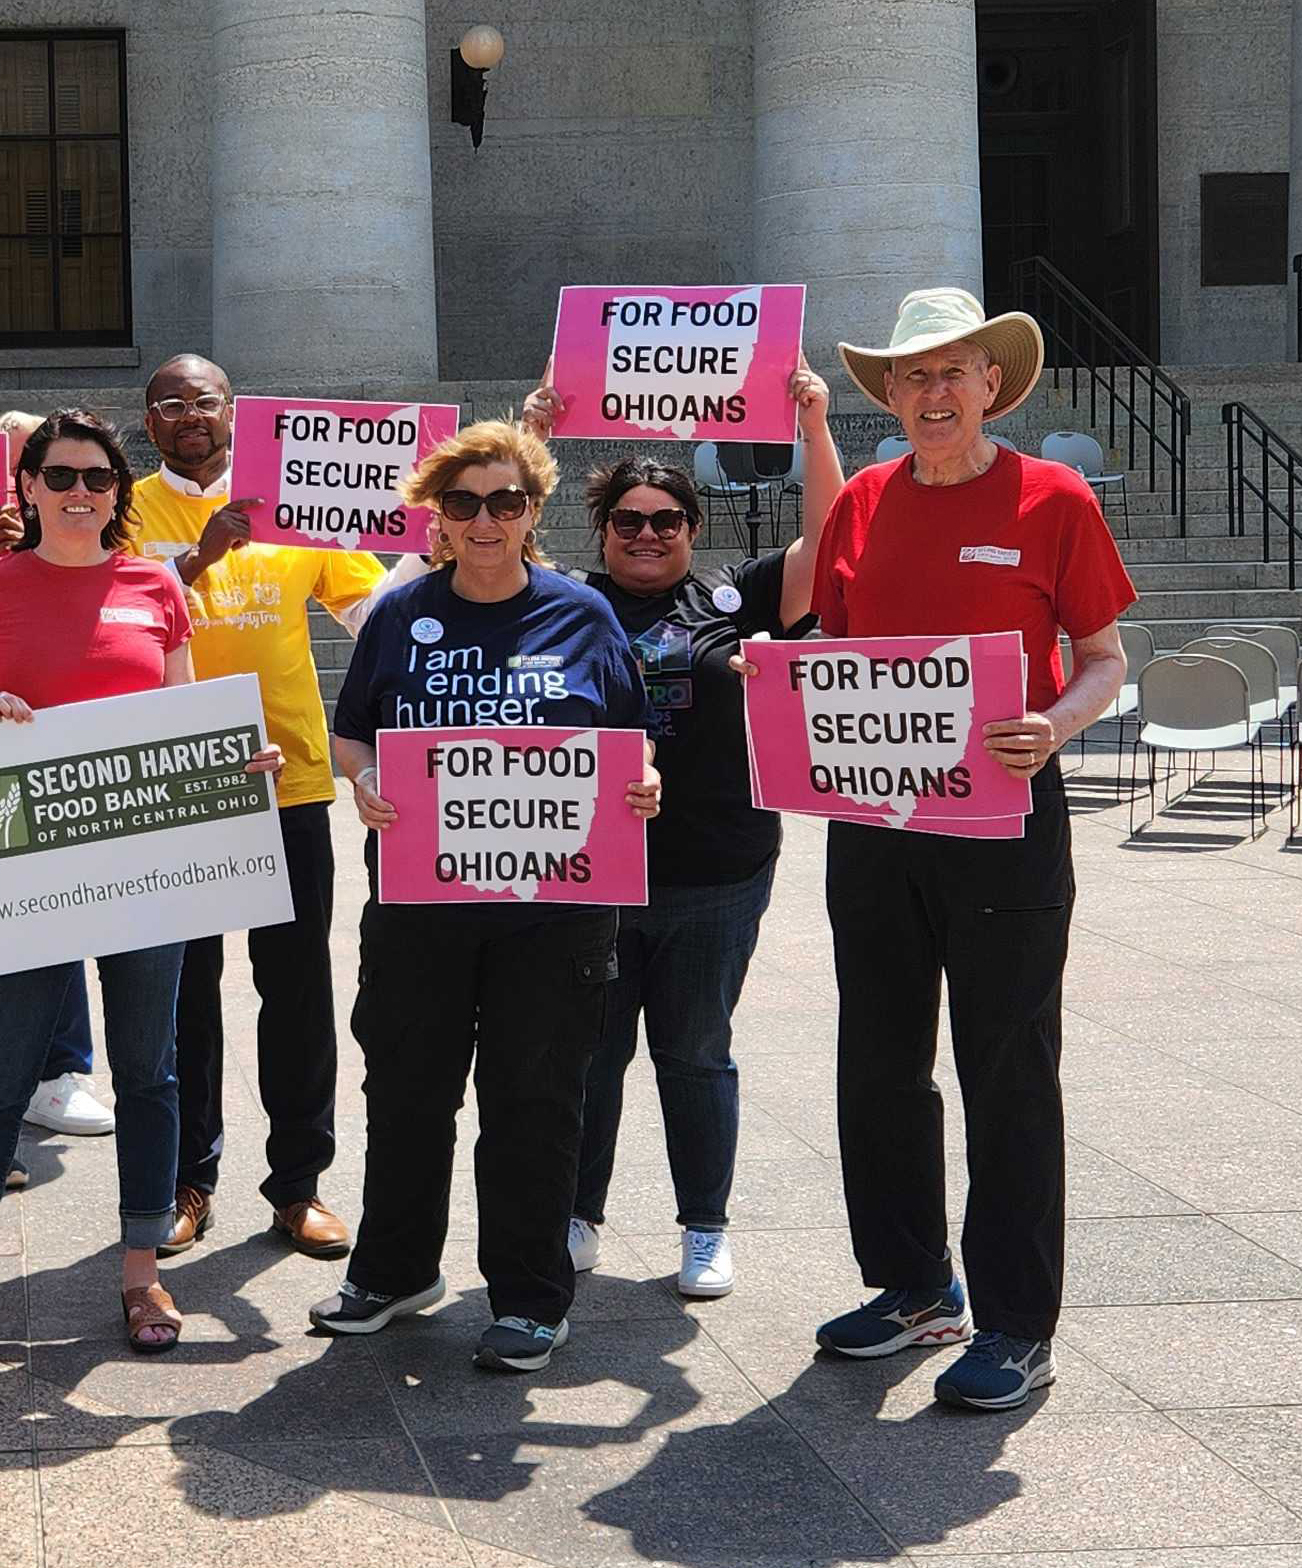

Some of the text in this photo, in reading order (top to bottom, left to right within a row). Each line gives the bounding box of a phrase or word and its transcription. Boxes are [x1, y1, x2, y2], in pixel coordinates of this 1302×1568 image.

[601, 301, 758, 327] FOR FOOD
[612, 344, 739, 375] SECURE
[601, 392, 746, 423] OHIOANS
[274, 414, 416, 446] FOR FOOD
[285, 459, 401, 491] SECURE
[274, 503, 407, 537] OHIOANS
[408, 645, 417, 673] I
[425, 645, 483, 671] am
[788, 656, 970, 692] FOR FOOD
[425, 667, 570, 700] ending
[396, 695, 545, 728] hunger.
[811, 712, 957, 745] SECURE
[27, 732, 252, 799] SECOND HARVEST
[426, 744, 596, 779] FOR FOOD
[809, 764, 972, 799] OHIOANS
[33, 773, 248, 825] FOOD BANK EST. 1982
[444, 798, 581, 831] SECURE
[37, 794, 260, 844] OF NORTH CENTRAL OHIO
[435, 850, 592, 885] OHIOANS
